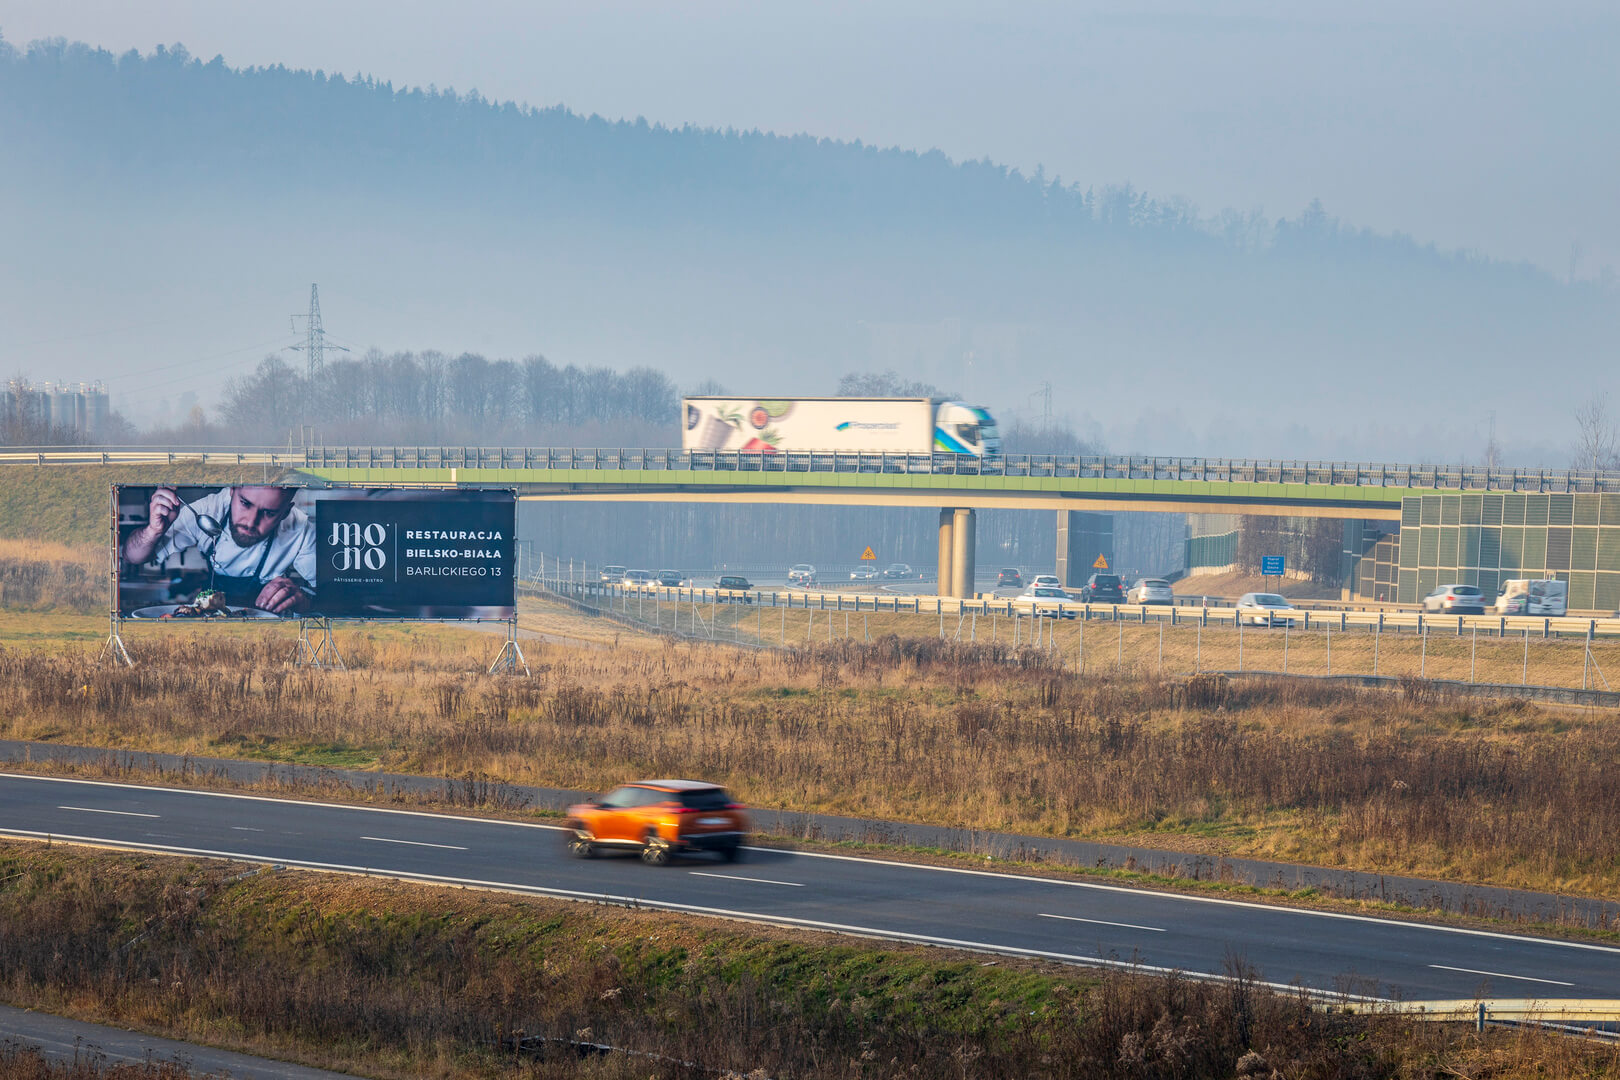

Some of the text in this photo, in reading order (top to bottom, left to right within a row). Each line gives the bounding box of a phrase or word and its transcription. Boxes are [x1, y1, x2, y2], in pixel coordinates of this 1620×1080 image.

[406, 530, 503, 540] RESTAURACJA
[406, 548, 502, 559] BIELSKO-BIAŁA
[406, 566, 502, 577] BARLICKIEGO 13
